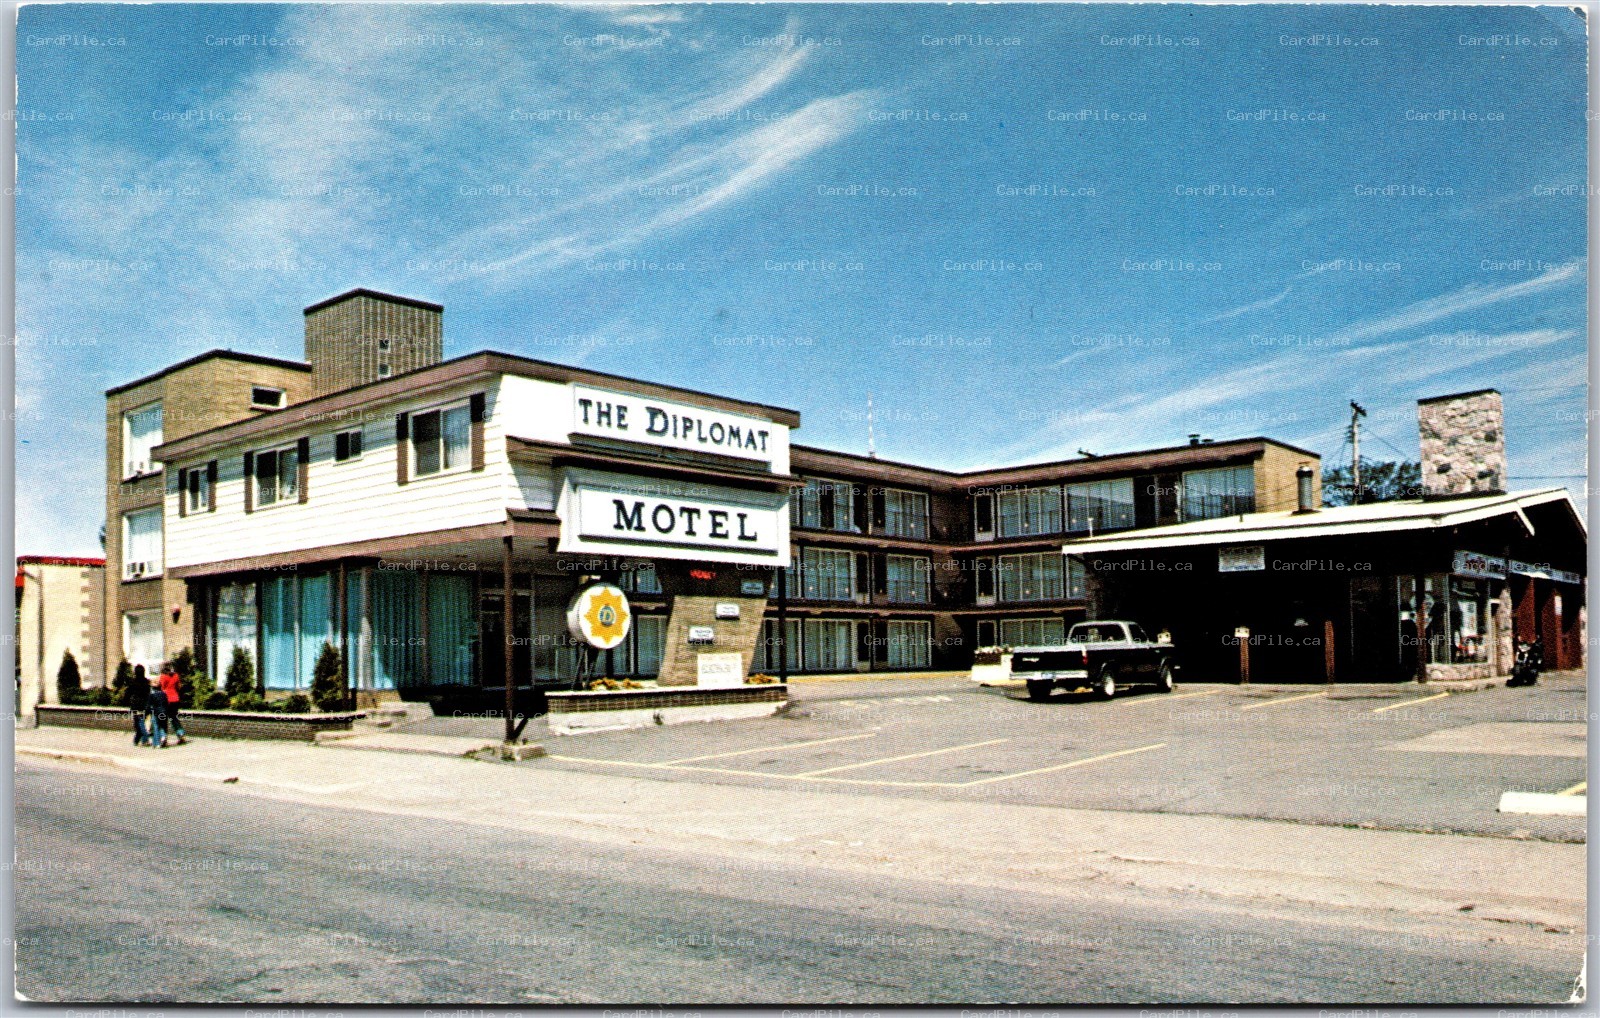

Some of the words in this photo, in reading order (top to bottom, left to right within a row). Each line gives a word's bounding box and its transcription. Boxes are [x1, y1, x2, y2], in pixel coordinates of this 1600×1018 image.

[578, 398, 629, 430] THE
[646, 406, 769, 453] DIPLOMAT
[612, 499, 758, 542] MOTEL
